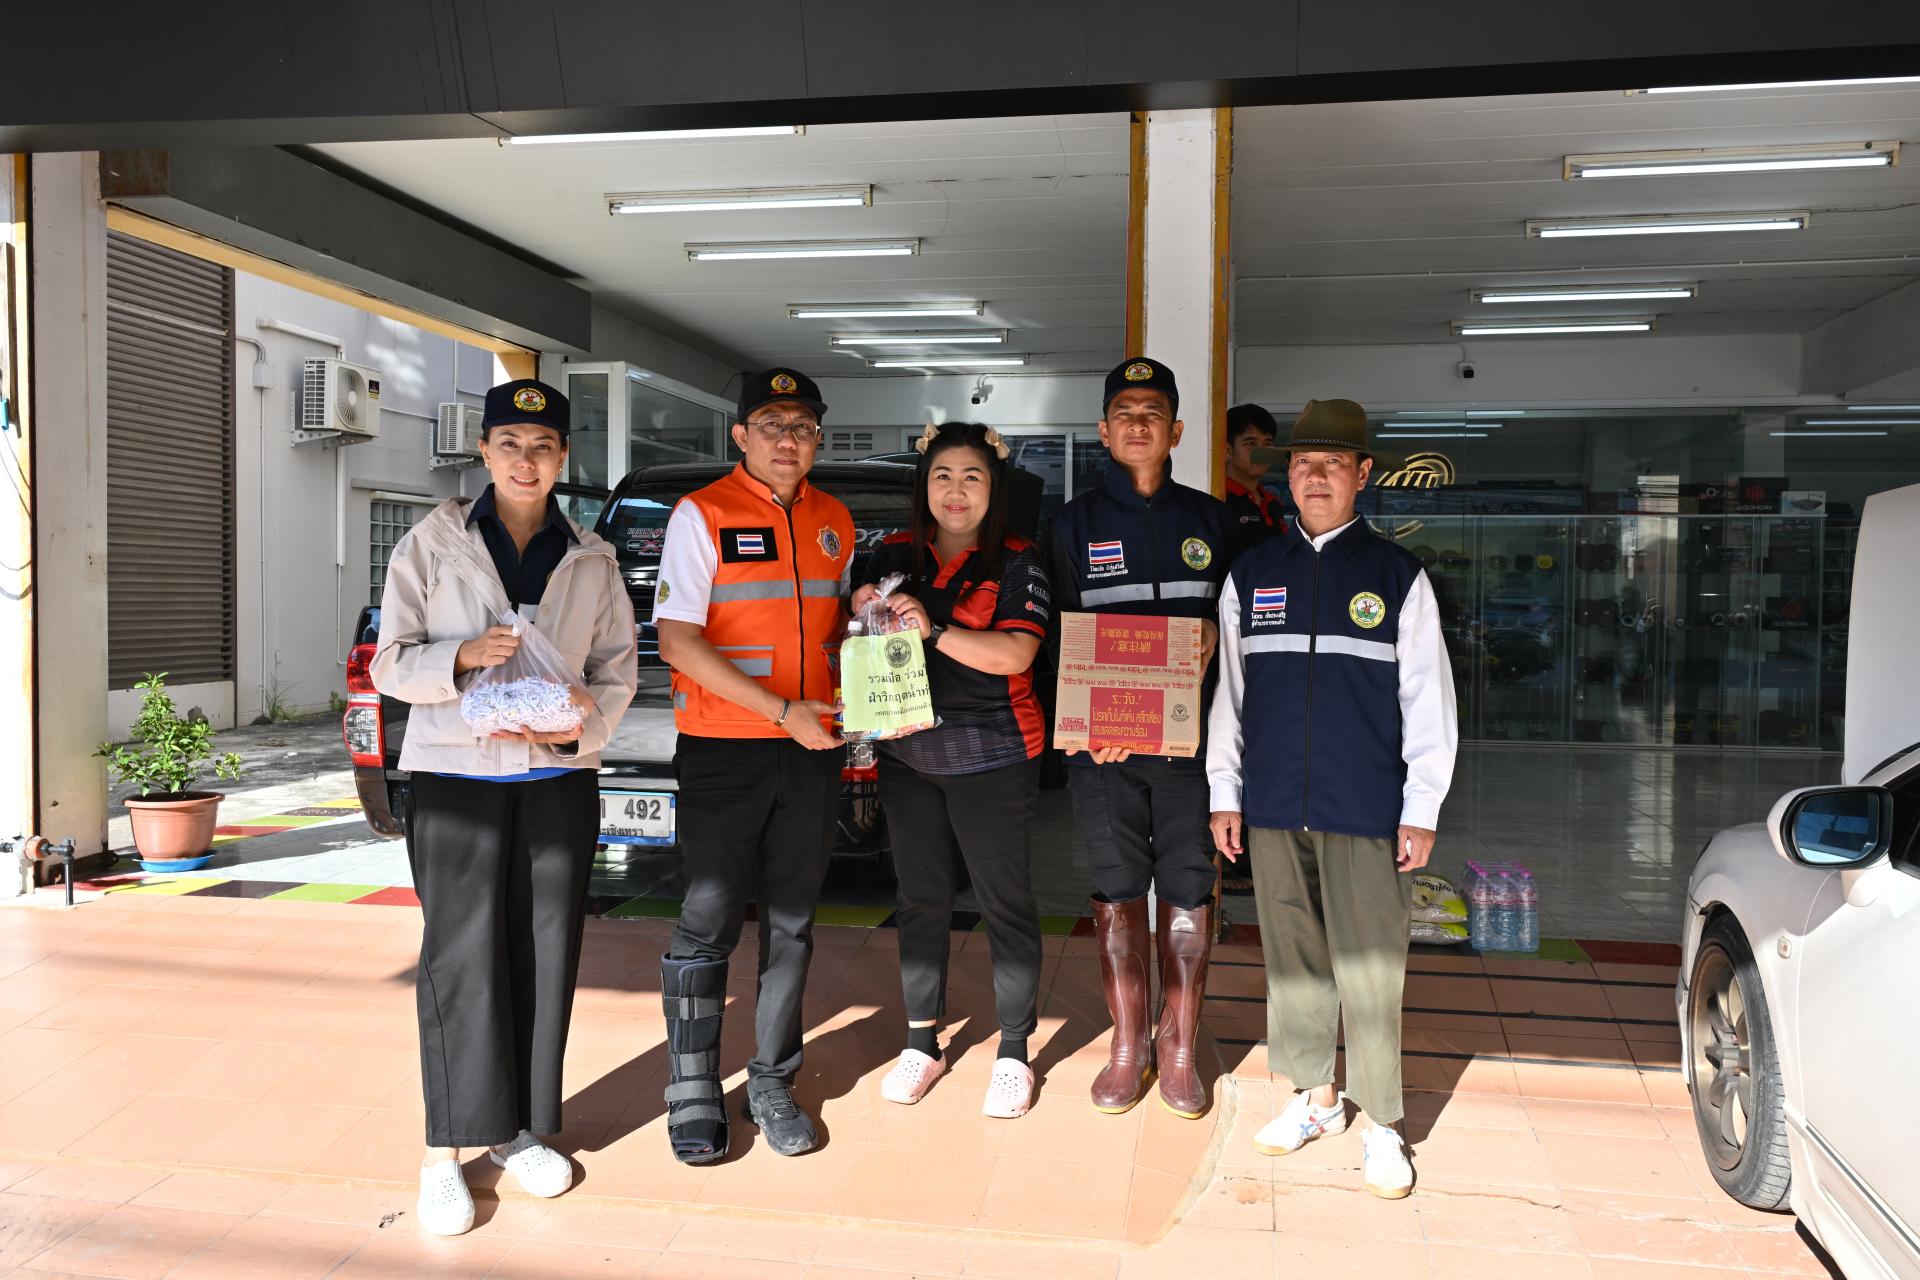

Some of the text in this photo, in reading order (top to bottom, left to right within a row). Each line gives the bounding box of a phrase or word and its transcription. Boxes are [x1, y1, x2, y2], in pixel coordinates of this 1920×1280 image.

[624, 798, 661, 820] 492
[600, 824, 644, 836] ะเชิงเทรา
